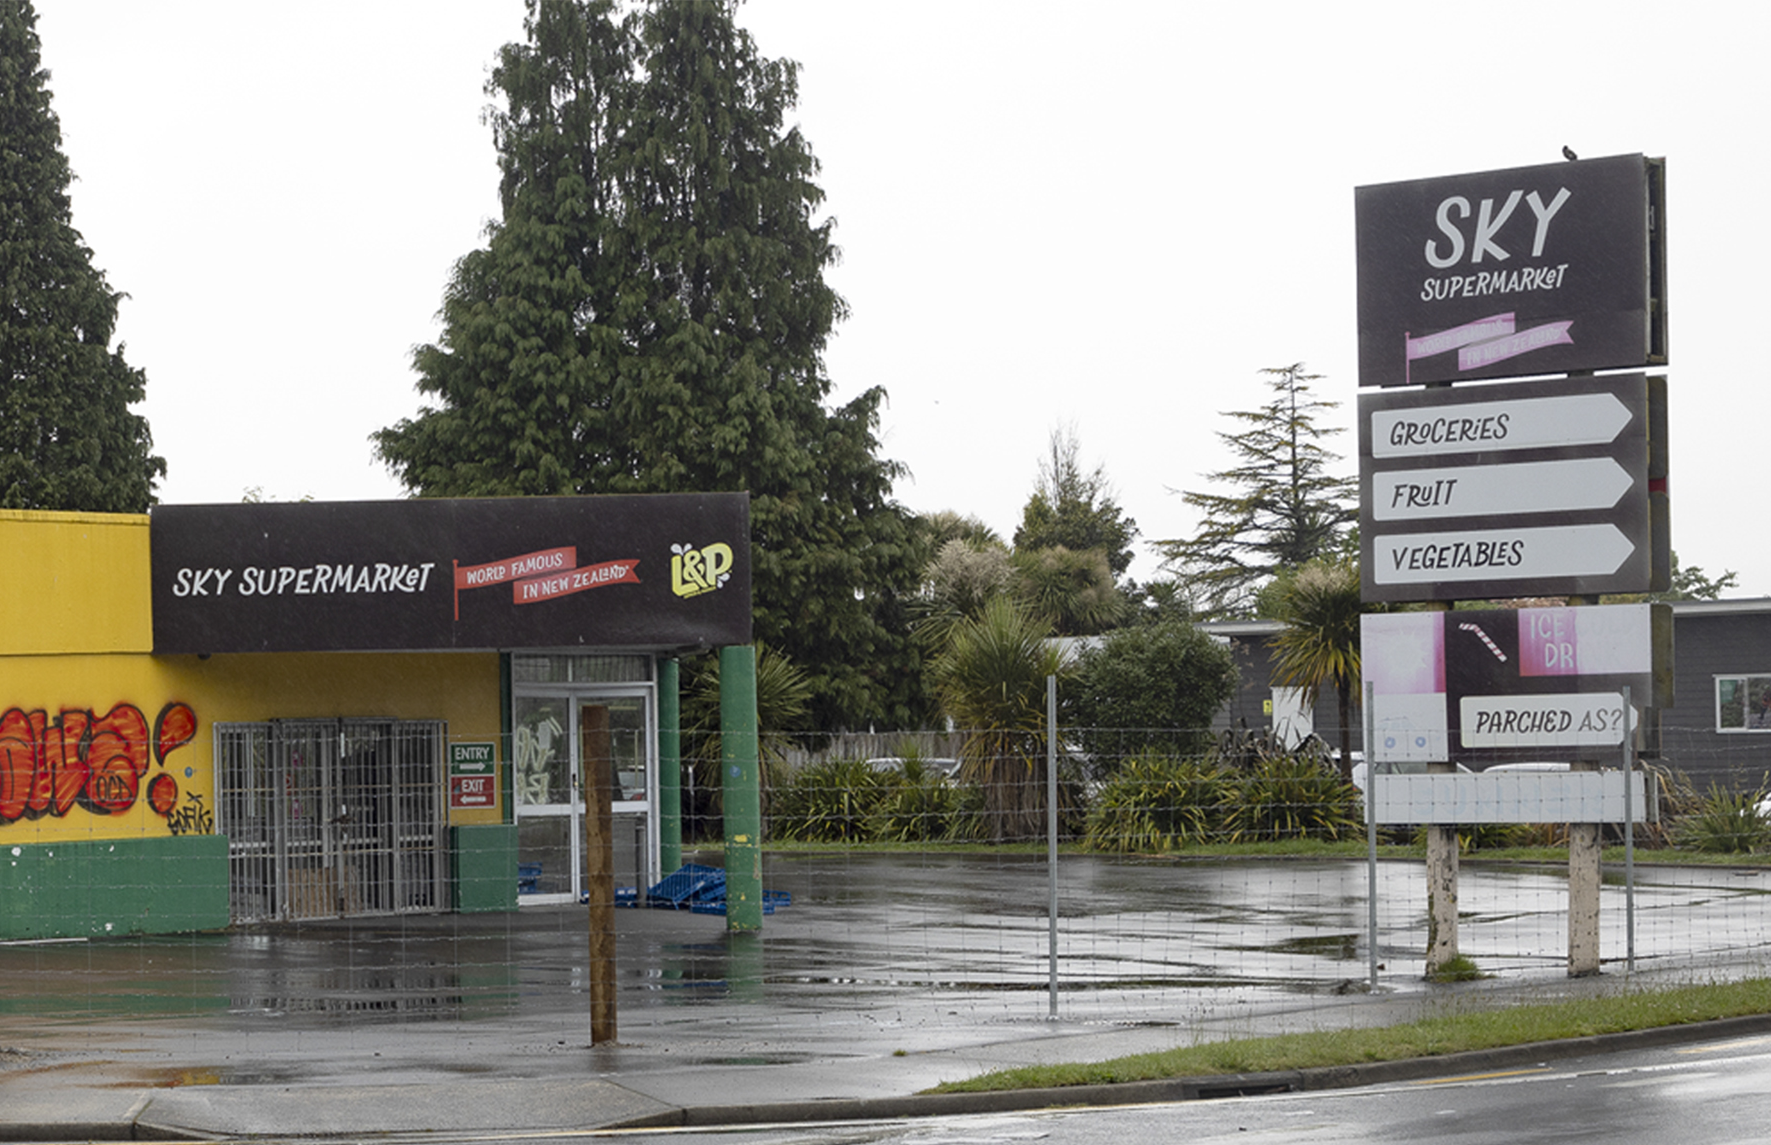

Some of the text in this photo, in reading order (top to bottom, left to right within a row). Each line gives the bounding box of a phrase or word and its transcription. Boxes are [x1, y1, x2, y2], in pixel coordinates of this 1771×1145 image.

[1425, 187, 1572, 268] SKY
[1391, 479, 1457, 508] FRUIT
[466, 552, 563, 584] WORLD FAMOUS
[671, 542, 734, 597] L&P
[1392, 540, 1525, 570] VEGETABLES
[173, 568, 232, 596] SKY
[523, 565, 628, 599] IN NEW ZEALAND
[1531, 614, 1564, 638] ICE
[1476, 708, 1572, 734] PARCHED
[455, 746, 490, 761] ENTRY
[462, 779, 485, 793] EXIT
